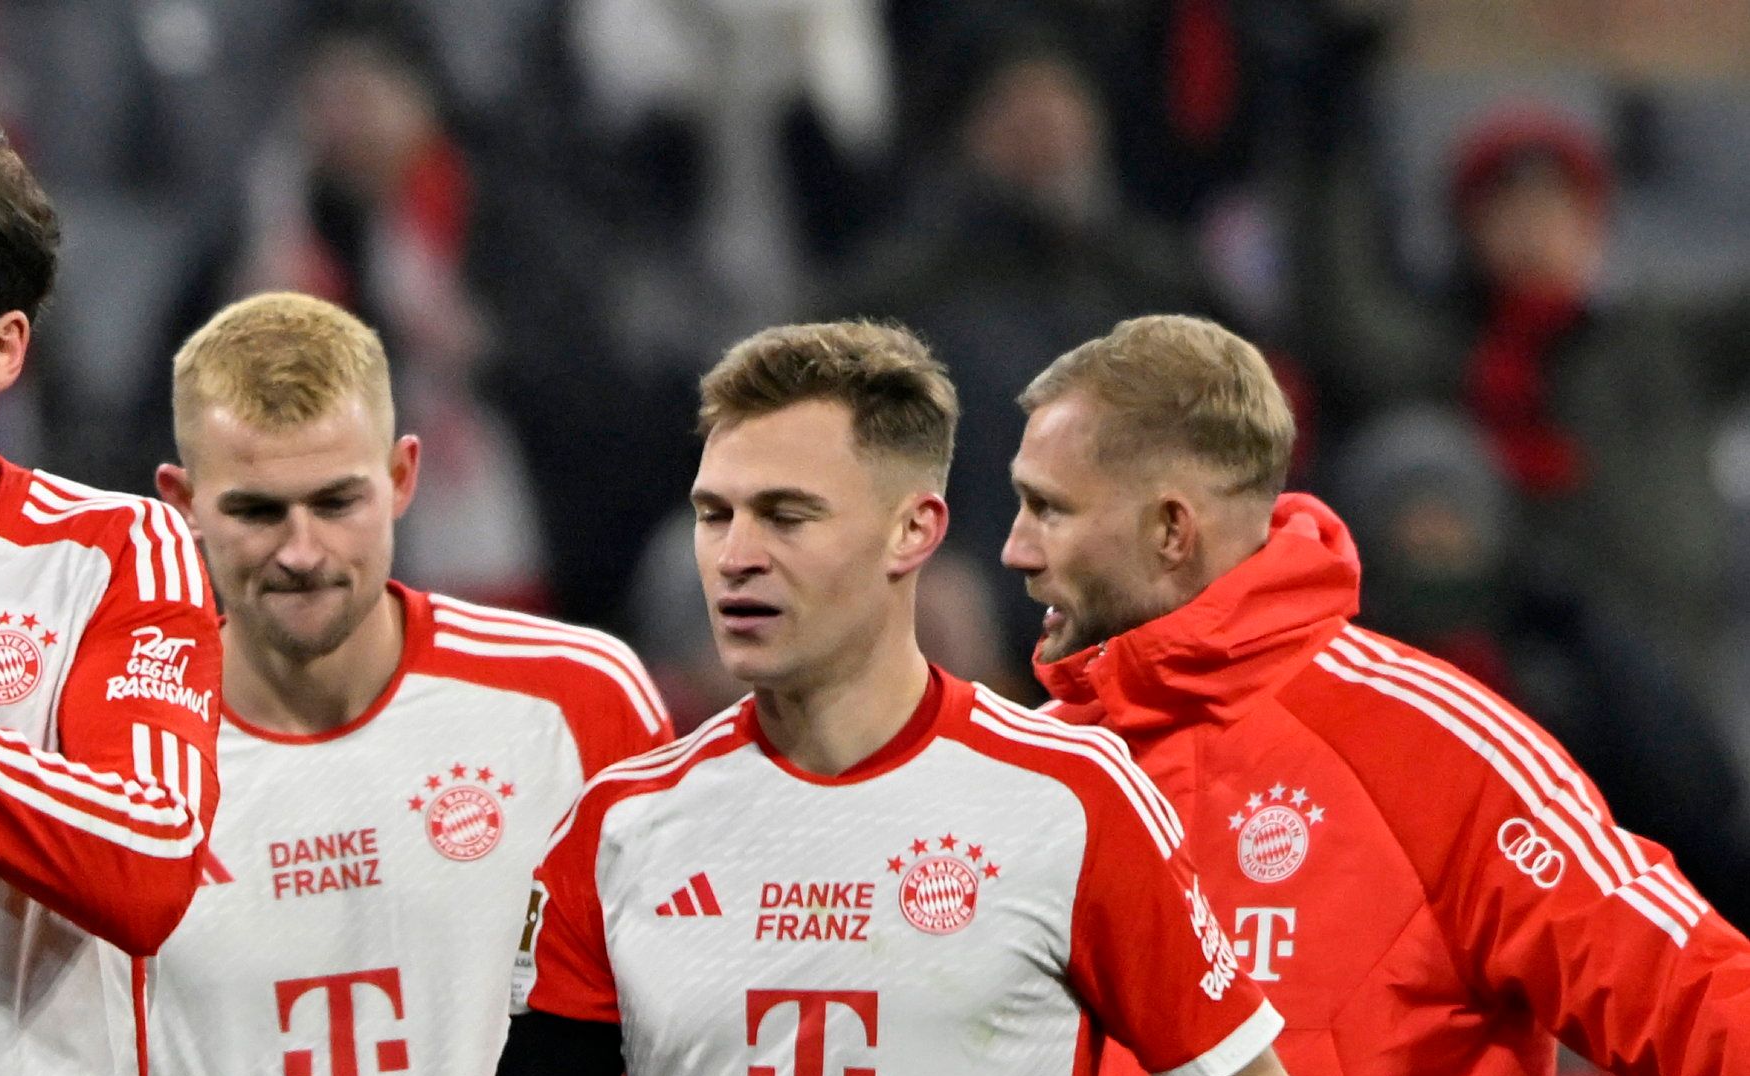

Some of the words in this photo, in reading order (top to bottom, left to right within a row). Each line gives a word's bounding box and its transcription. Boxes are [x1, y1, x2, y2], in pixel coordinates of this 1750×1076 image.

[130, 625, 196, 664] ROT
[126, 655, 189, 686] GEGEN
[106, 675, 213, 723] RASSISMUS
[269, 827, 379, 868] DANKE
[272, 858, 383, 900] FRANZ
[760, 881, 876, 909] DANKE
[754, 913, 872, 942] FRANZ
[1233, 906, 1297, 982] T
